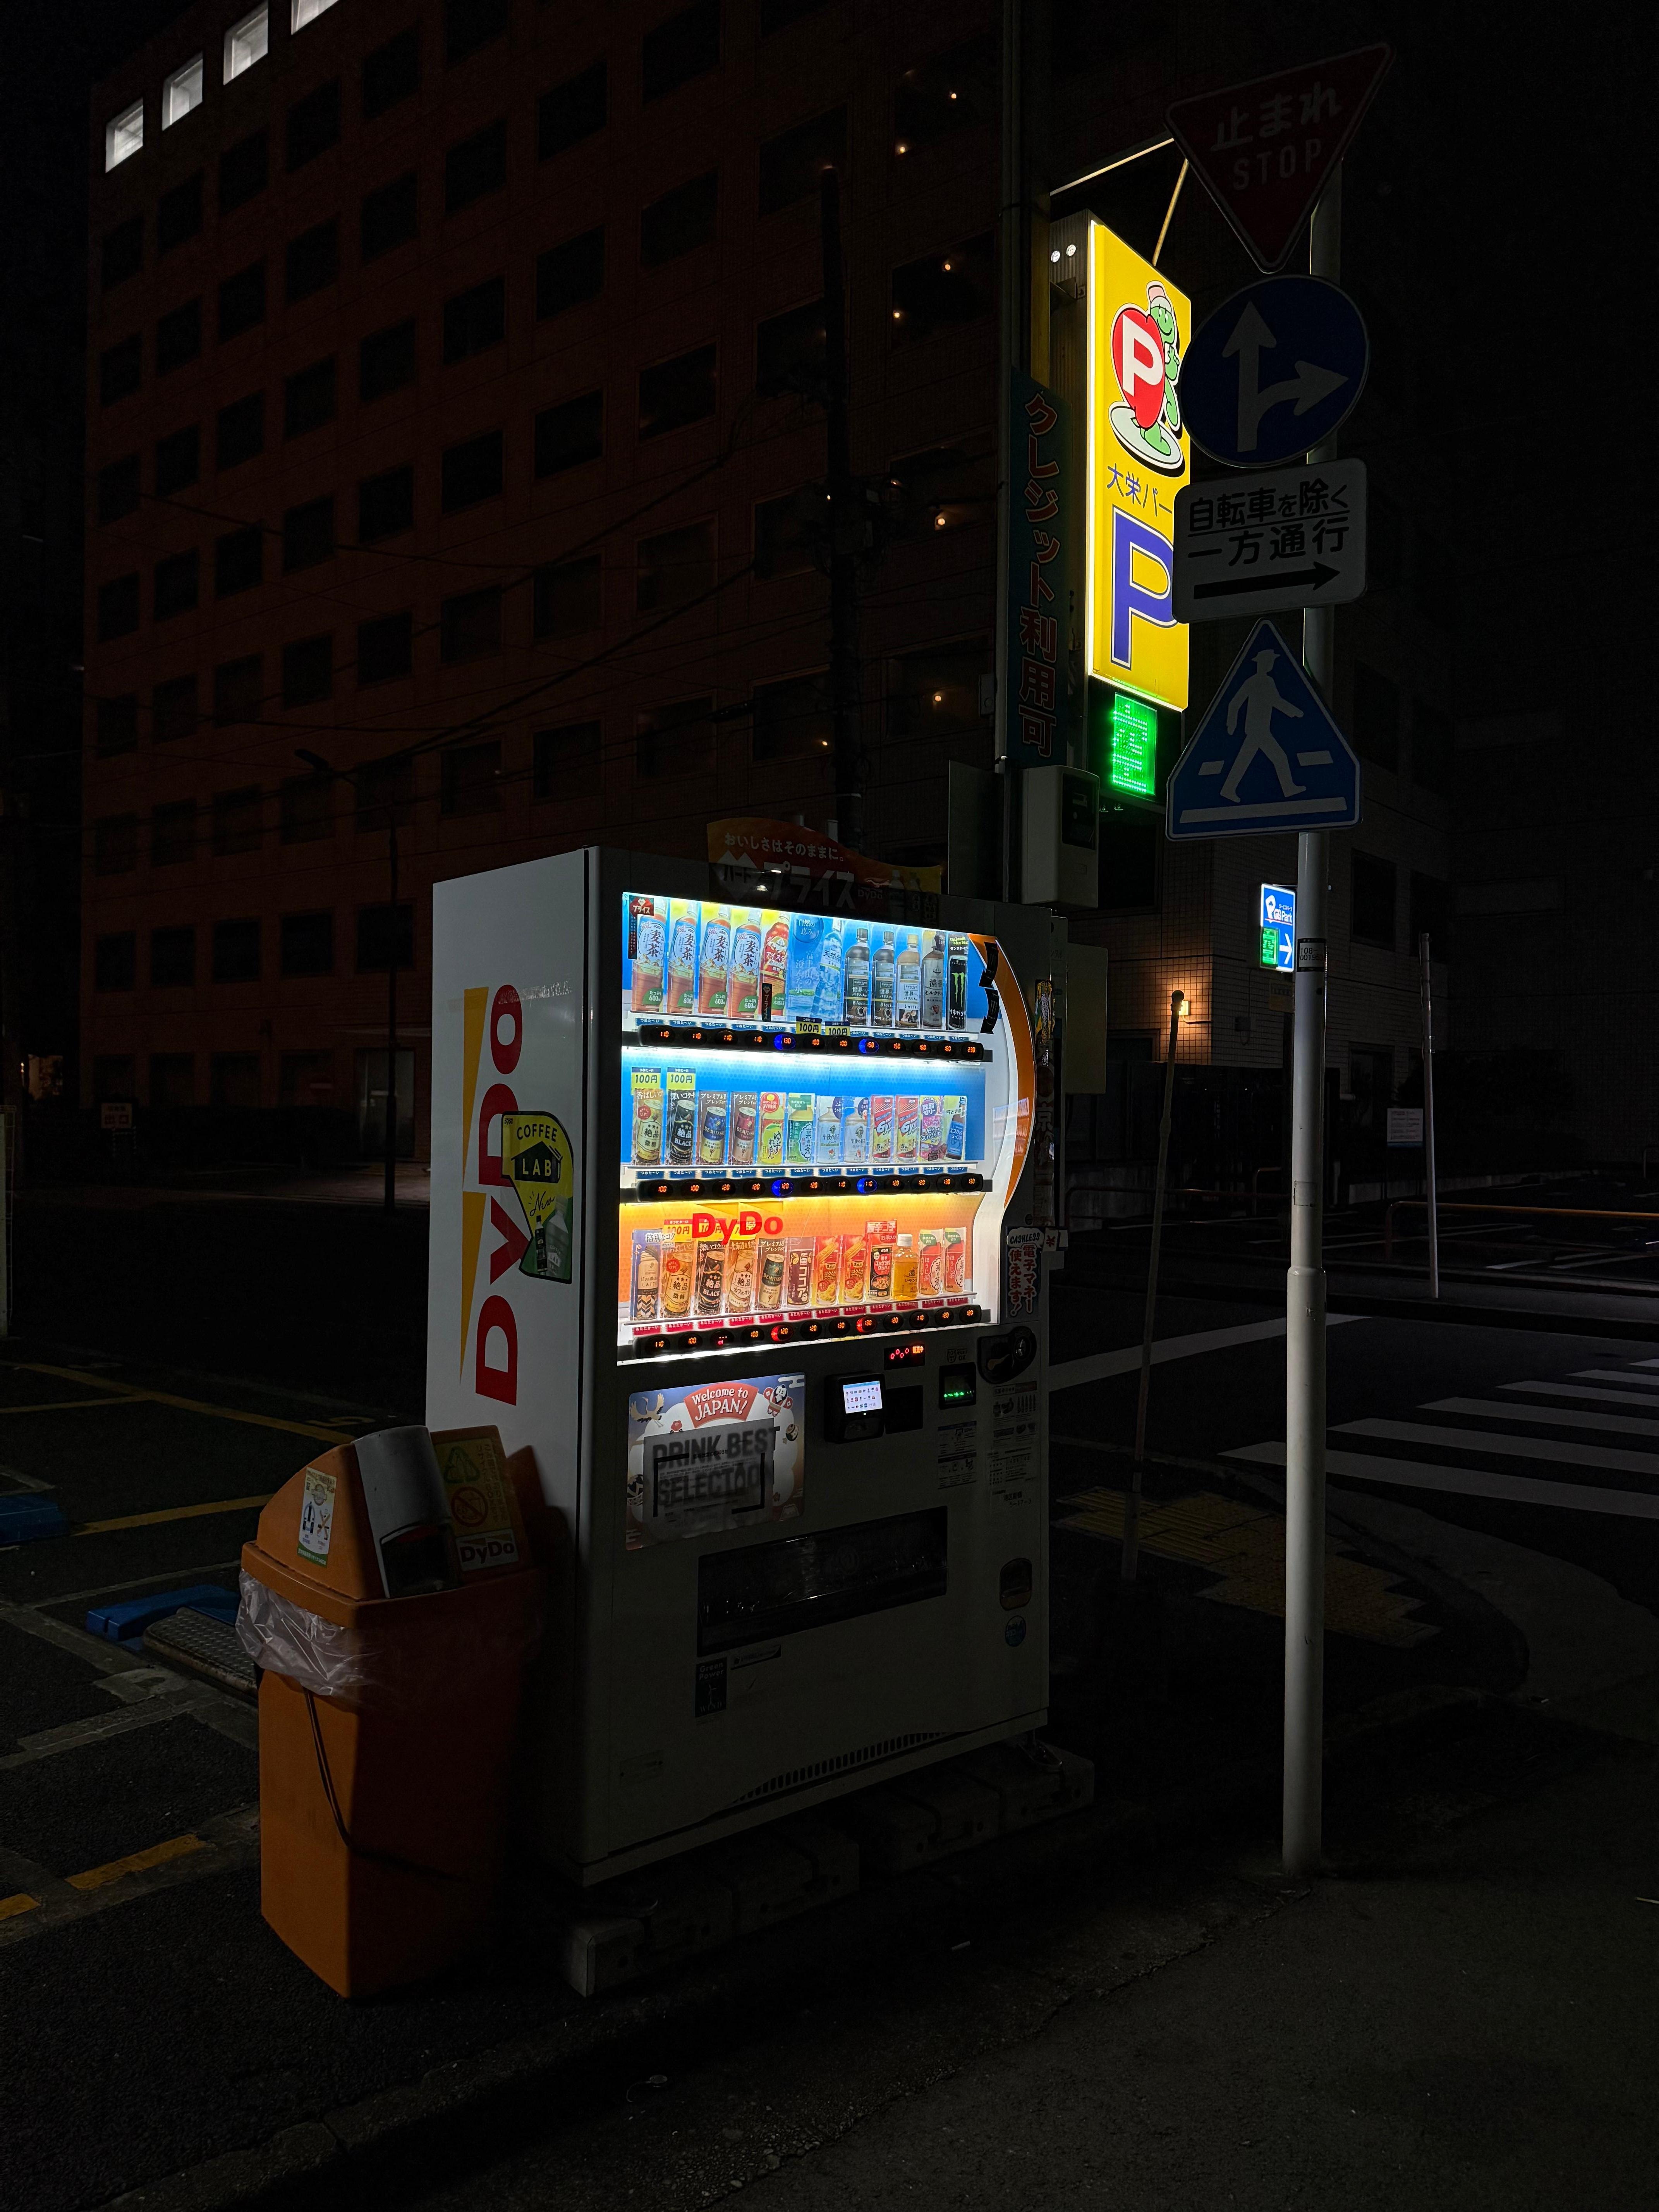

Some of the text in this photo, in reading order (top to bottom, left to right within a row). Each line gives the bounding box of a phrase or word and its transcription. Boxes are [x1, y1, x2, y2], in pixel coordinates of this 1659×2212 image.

[1210, 81, 1344, 153] 止まれ
[1232, 138, 1322, 191] STOP
[1122, 313, 1164, 397] P
[1189, 478, 1348, 533] 自転車を除く
[1187, 517, 1350, 567] 一方通行
[1018, 393, 1061, 759] クレジット利用可
[1112, 504, 1179, 668] P
[724, 832, 845, 862] おいしさはそのままに。
[647, 929, 661, 958] 麦茶
[682, 934, 694, 961] 麦茶
[713, 935, 726, 962] 麦茶
[742, 940, 756, 967] 麦茶
[799, 1023, 819, 1034] 100円
[635, 1075, 658, 1084] 100円
[670, 1074, 692, 1084] 100円
[517, 1124, 558, 1142] COFFEE
[644, 1129, 659, 1138] 絶品
[674, 1138, 692, 1146] BLACK
[677, 1128, 692, 1139] 絶品
[774, 1131, 781, 1154] ゆず
[522, 1158, 552, 1176] LAB
[529, 1191, 555, 1216] New
[692, 1211, 783, 1245] DyDo
[1010, 1232, 1040, 1244] CASHLESS
[673, 1281, 688, 1291] 絶品
[705, 1279, 720, 1289] 絶品
[737, 1278, 750, 1286] 絶品
[797, 1266, 807, 1298] ココア
[1023, 1245, 1036, 1312] 電子マネー
[702, 1288, 720, 1297] BLACK
[692, 1387, 749, 1405] Welcome to
[695, 1398, 748, 1421] JAPAN!
[653, 1435, 721, 1470] DRINK
[726, 1426, 780, 1459] BEST
[460, 1540, 515, 1565] DyDo
[699, 1669, 724, 1681] Power
[700, 1662, 723, 1673] Green
